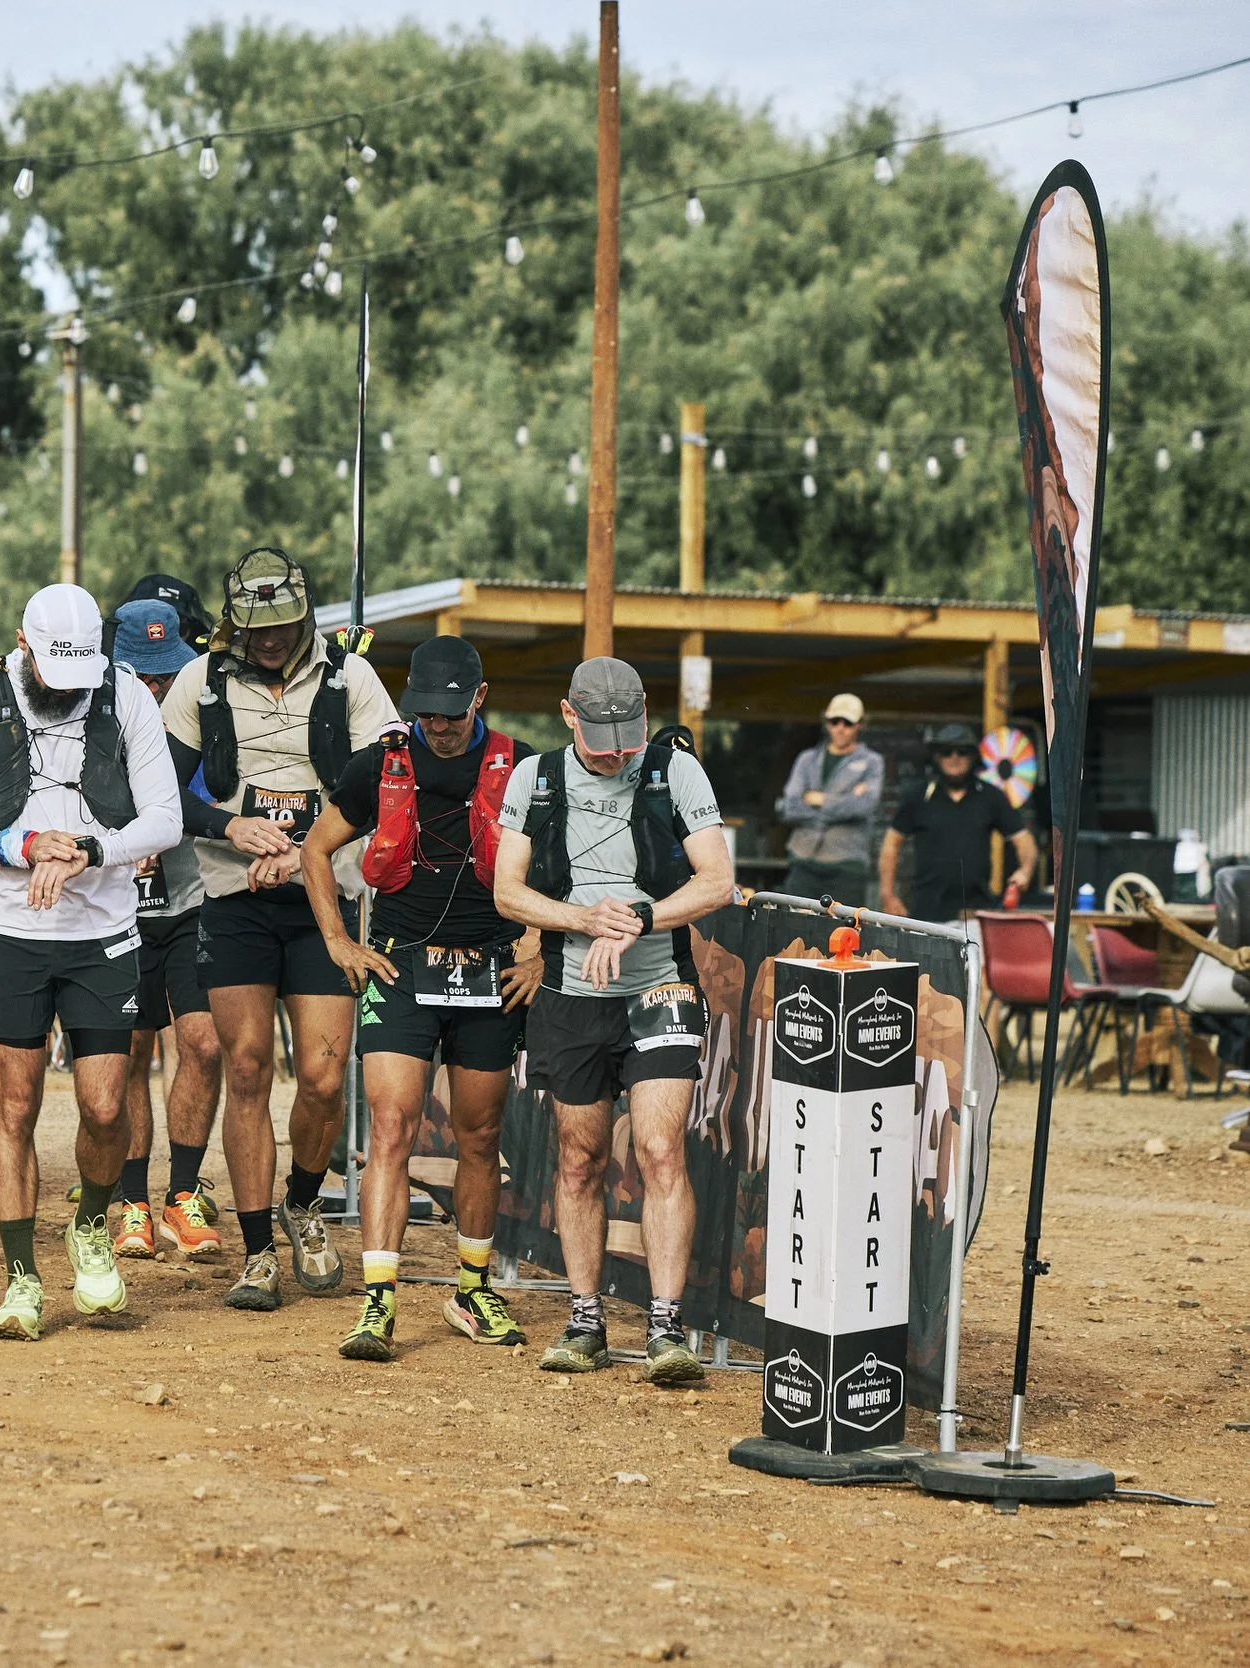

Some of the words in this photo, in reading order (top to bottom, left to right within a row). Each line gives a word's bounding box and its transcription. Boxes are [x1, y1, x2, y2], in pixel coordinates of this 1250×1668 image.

[50, 648, 96, 657] STATION
[51, 640, 72, 648] AID
[254, 794, 278, 808] IKARA
[280, 798, 306, 810] ULTRA
[501, 802, 517, 818] RUN
[598, 800, 618, 814] T8
[139, 878, 152, 898] 7
[448, 964, 464, 986] 4
[642, 990, 668, 1010] IKARA
[670, 988, 696, 1004] ULTRA
[668, 1001, 680, 1023] 1
[786, 1021, 798, 1037] MMI
[800, 1024, 822, 1042] EVENTS
[858, 1028, 874, 1044] MMI
[876, 1025, 900, 1042] EVENTS
[792, 1098, 806, 1309] START
[866, 1102, 883, 1312] START
[774, 1383, 788, 1400] MMI
[788, 1387, 812, 1408] EVENTS
[848, 1394, 864, 1410] MMI
[866, 1388, 890, 1408] EVENTS
